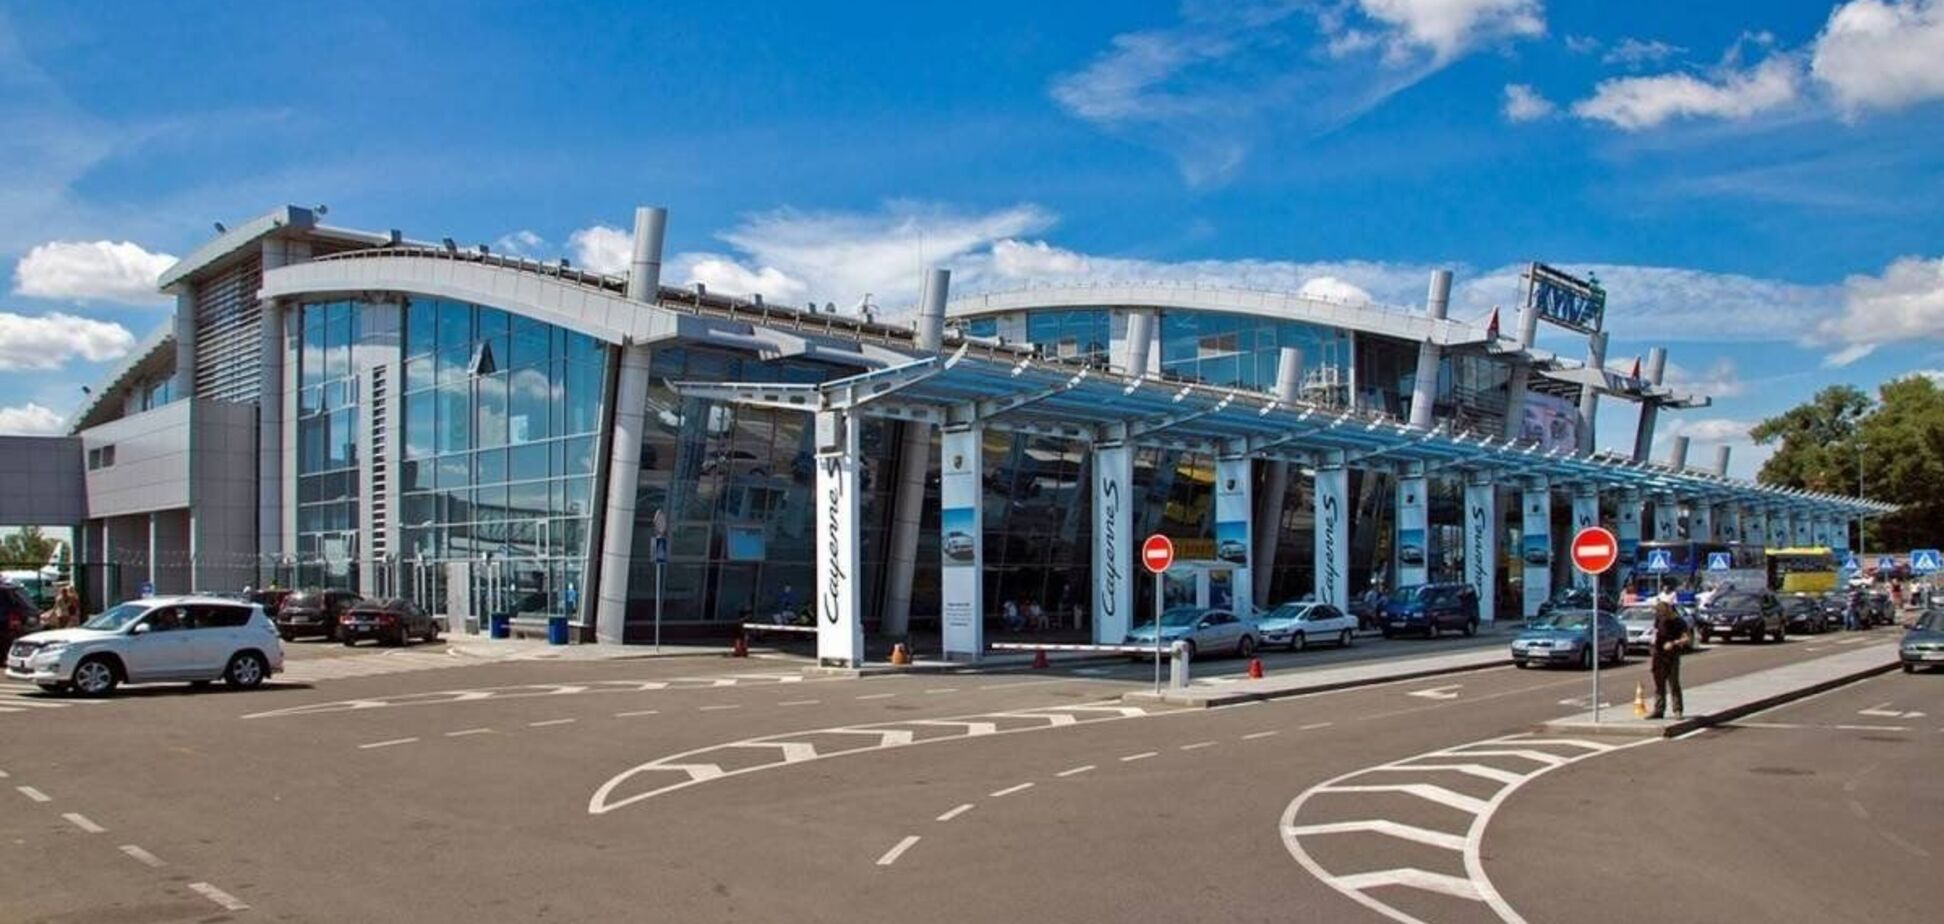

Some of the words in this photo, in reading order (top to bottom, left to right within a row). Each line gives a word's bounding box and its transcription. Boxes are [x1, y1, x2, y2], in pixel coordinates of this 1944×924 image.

[826, 457, 844, 497] S
[1103, 477, 1119, 512] S
[1323, 494, 1338, 523] S
[1473, 506, 1486, 529] S
[825, 488, 847, 624] Cayenne
[1101, 505, 1122, 616] Cayenne
[1322, 516, 1340, 604] Cayenne
